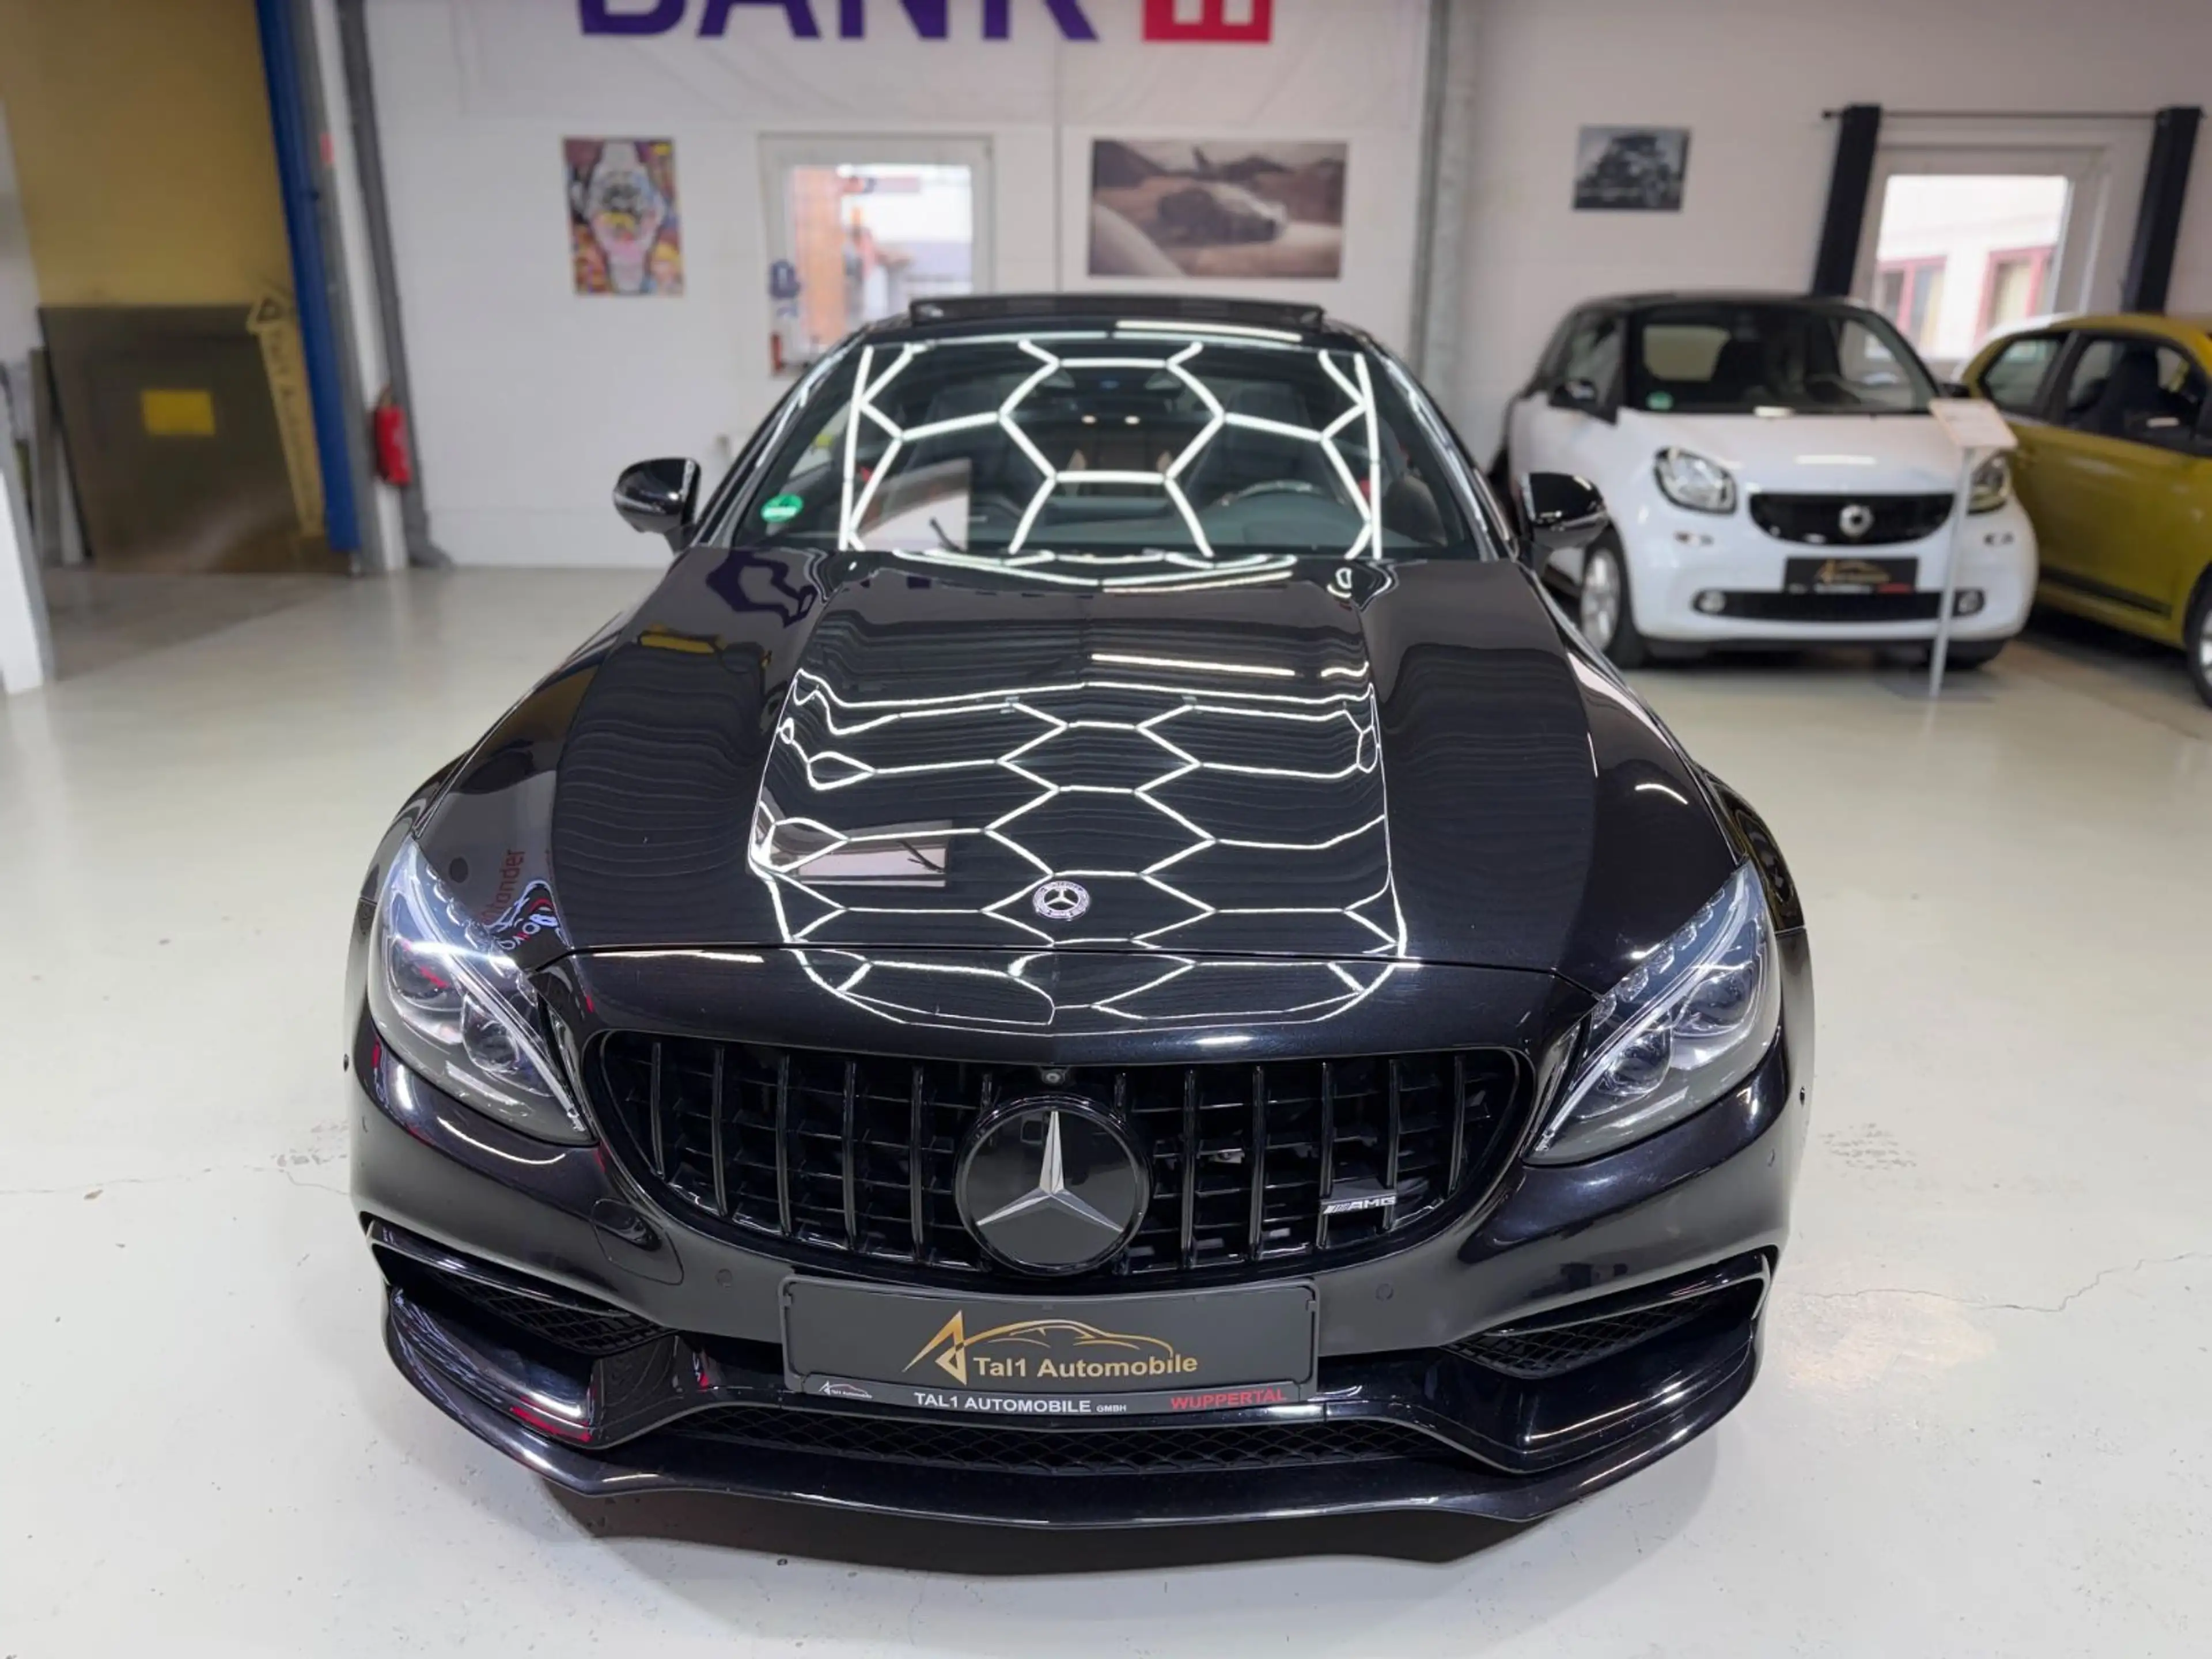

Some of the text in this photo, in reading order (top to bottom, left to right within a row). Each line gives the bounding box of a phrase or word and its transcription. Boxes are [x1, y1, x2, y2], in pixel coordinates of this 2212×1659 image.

[1349, 1195, 1396, 1210] AMG
[973, 1354, 1198, 1378] Tal1 Automobile
[914, 1392, 959, 1407] TAL1
[964, 1397, 1092, 1412] AUTOMOBILE
[1171, 1388, 1287, 1410] WUPPERTAL
